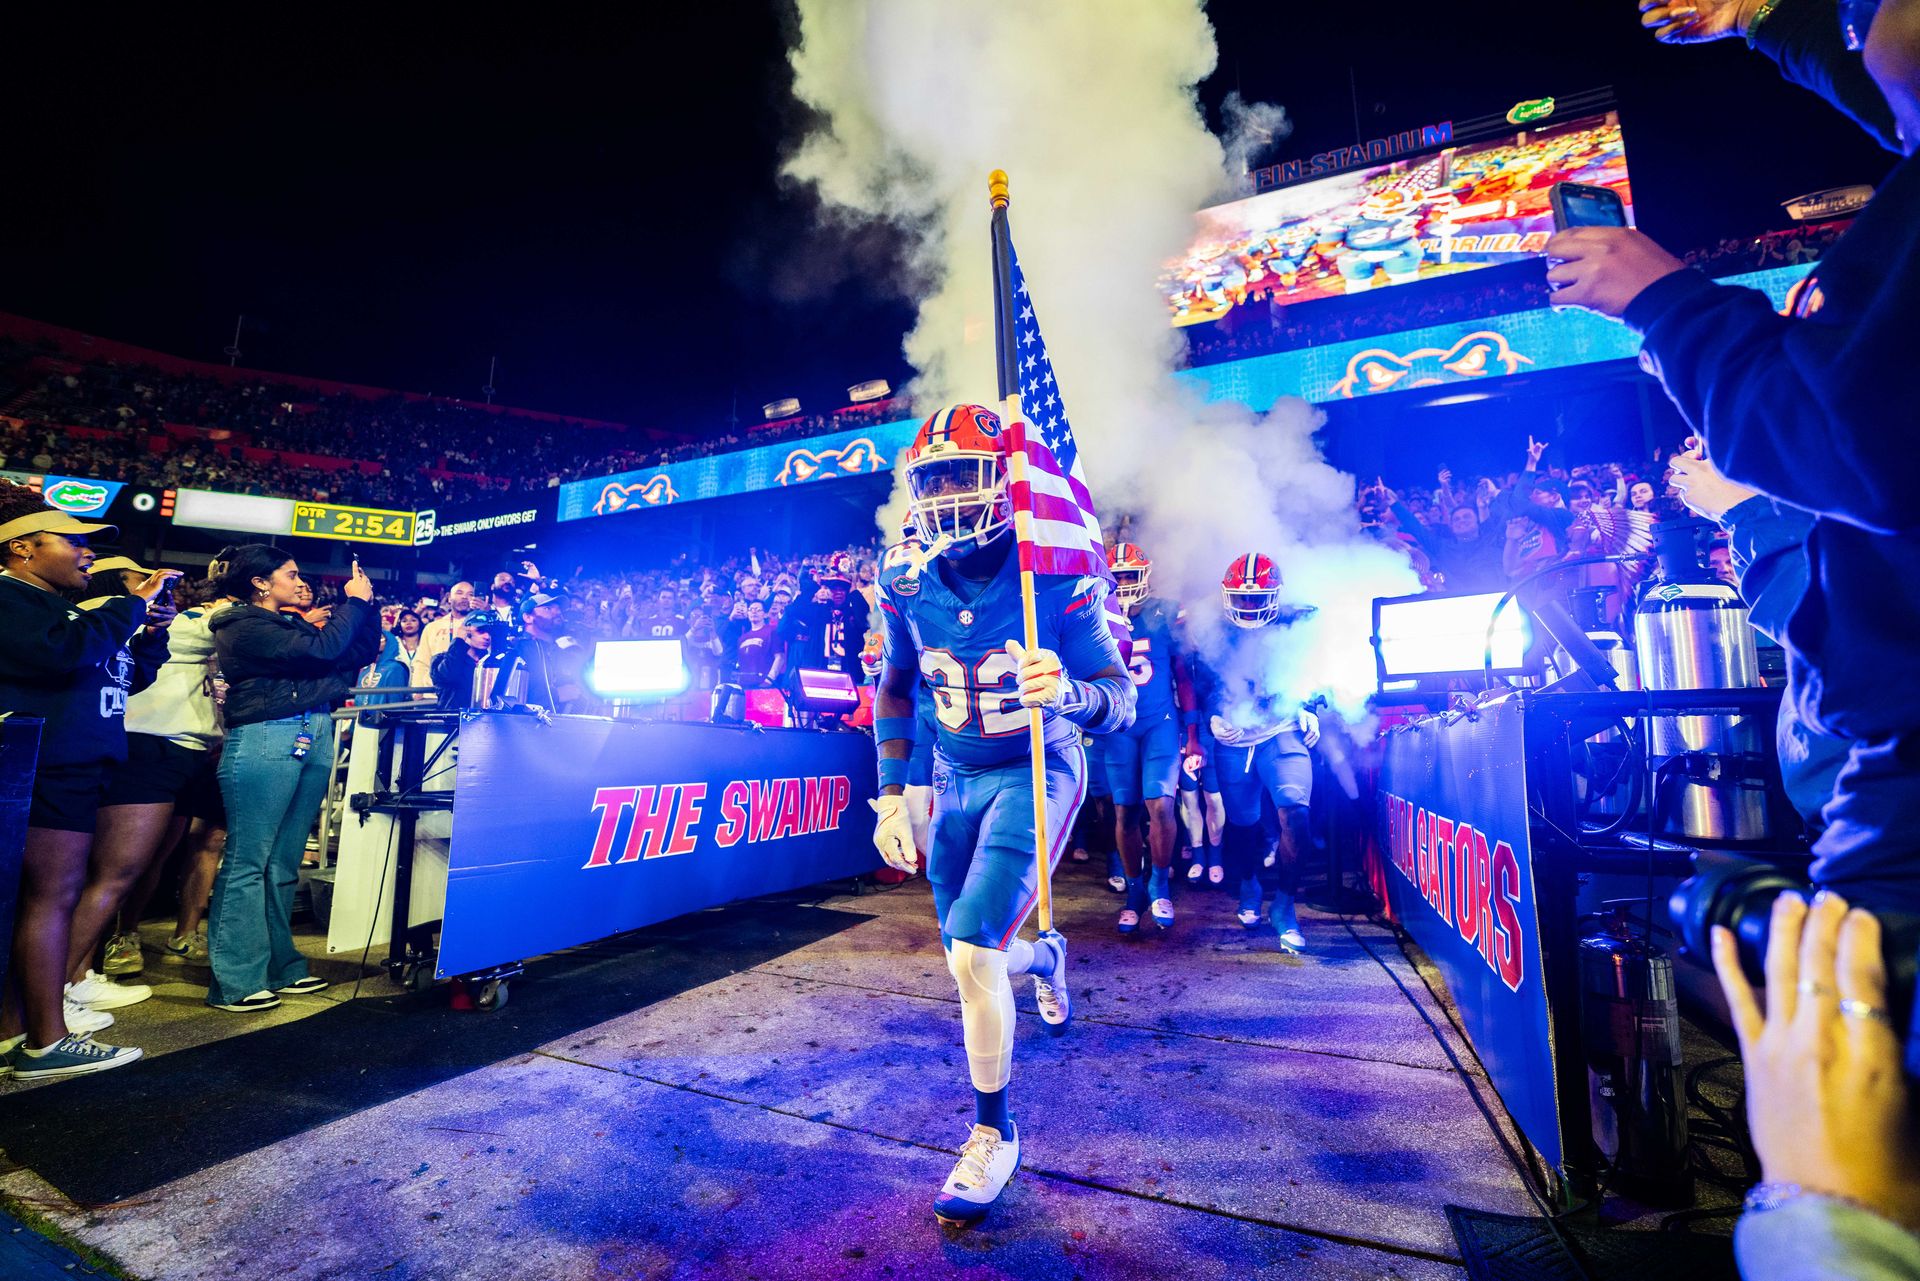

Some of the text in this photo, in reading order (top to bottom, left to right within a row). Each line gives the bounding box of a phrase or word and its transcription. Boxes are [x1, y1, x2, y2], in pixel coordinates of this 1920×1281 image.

[1250, 121, 1453, 188] FIN STADIUM
[1419, 231, 1552, 254] FLRIDA
[297, 507, 326, 518] QTR
[307, 519, 316, 531] 1
[333, 512, 405, 538] 2:54
[440, 524, 454, 537] THE
[477, 517, 495, 531] ONLY
[494, 512, 521, 528] GATORS
[521, 509, 537, 523] GET
[416, 518, 434, 539] 25
[918, 645, 1042, 739] 32
[581, 775, 851, 870] THE SWAMP
[1416, 807, 1523, 992] GATORS
